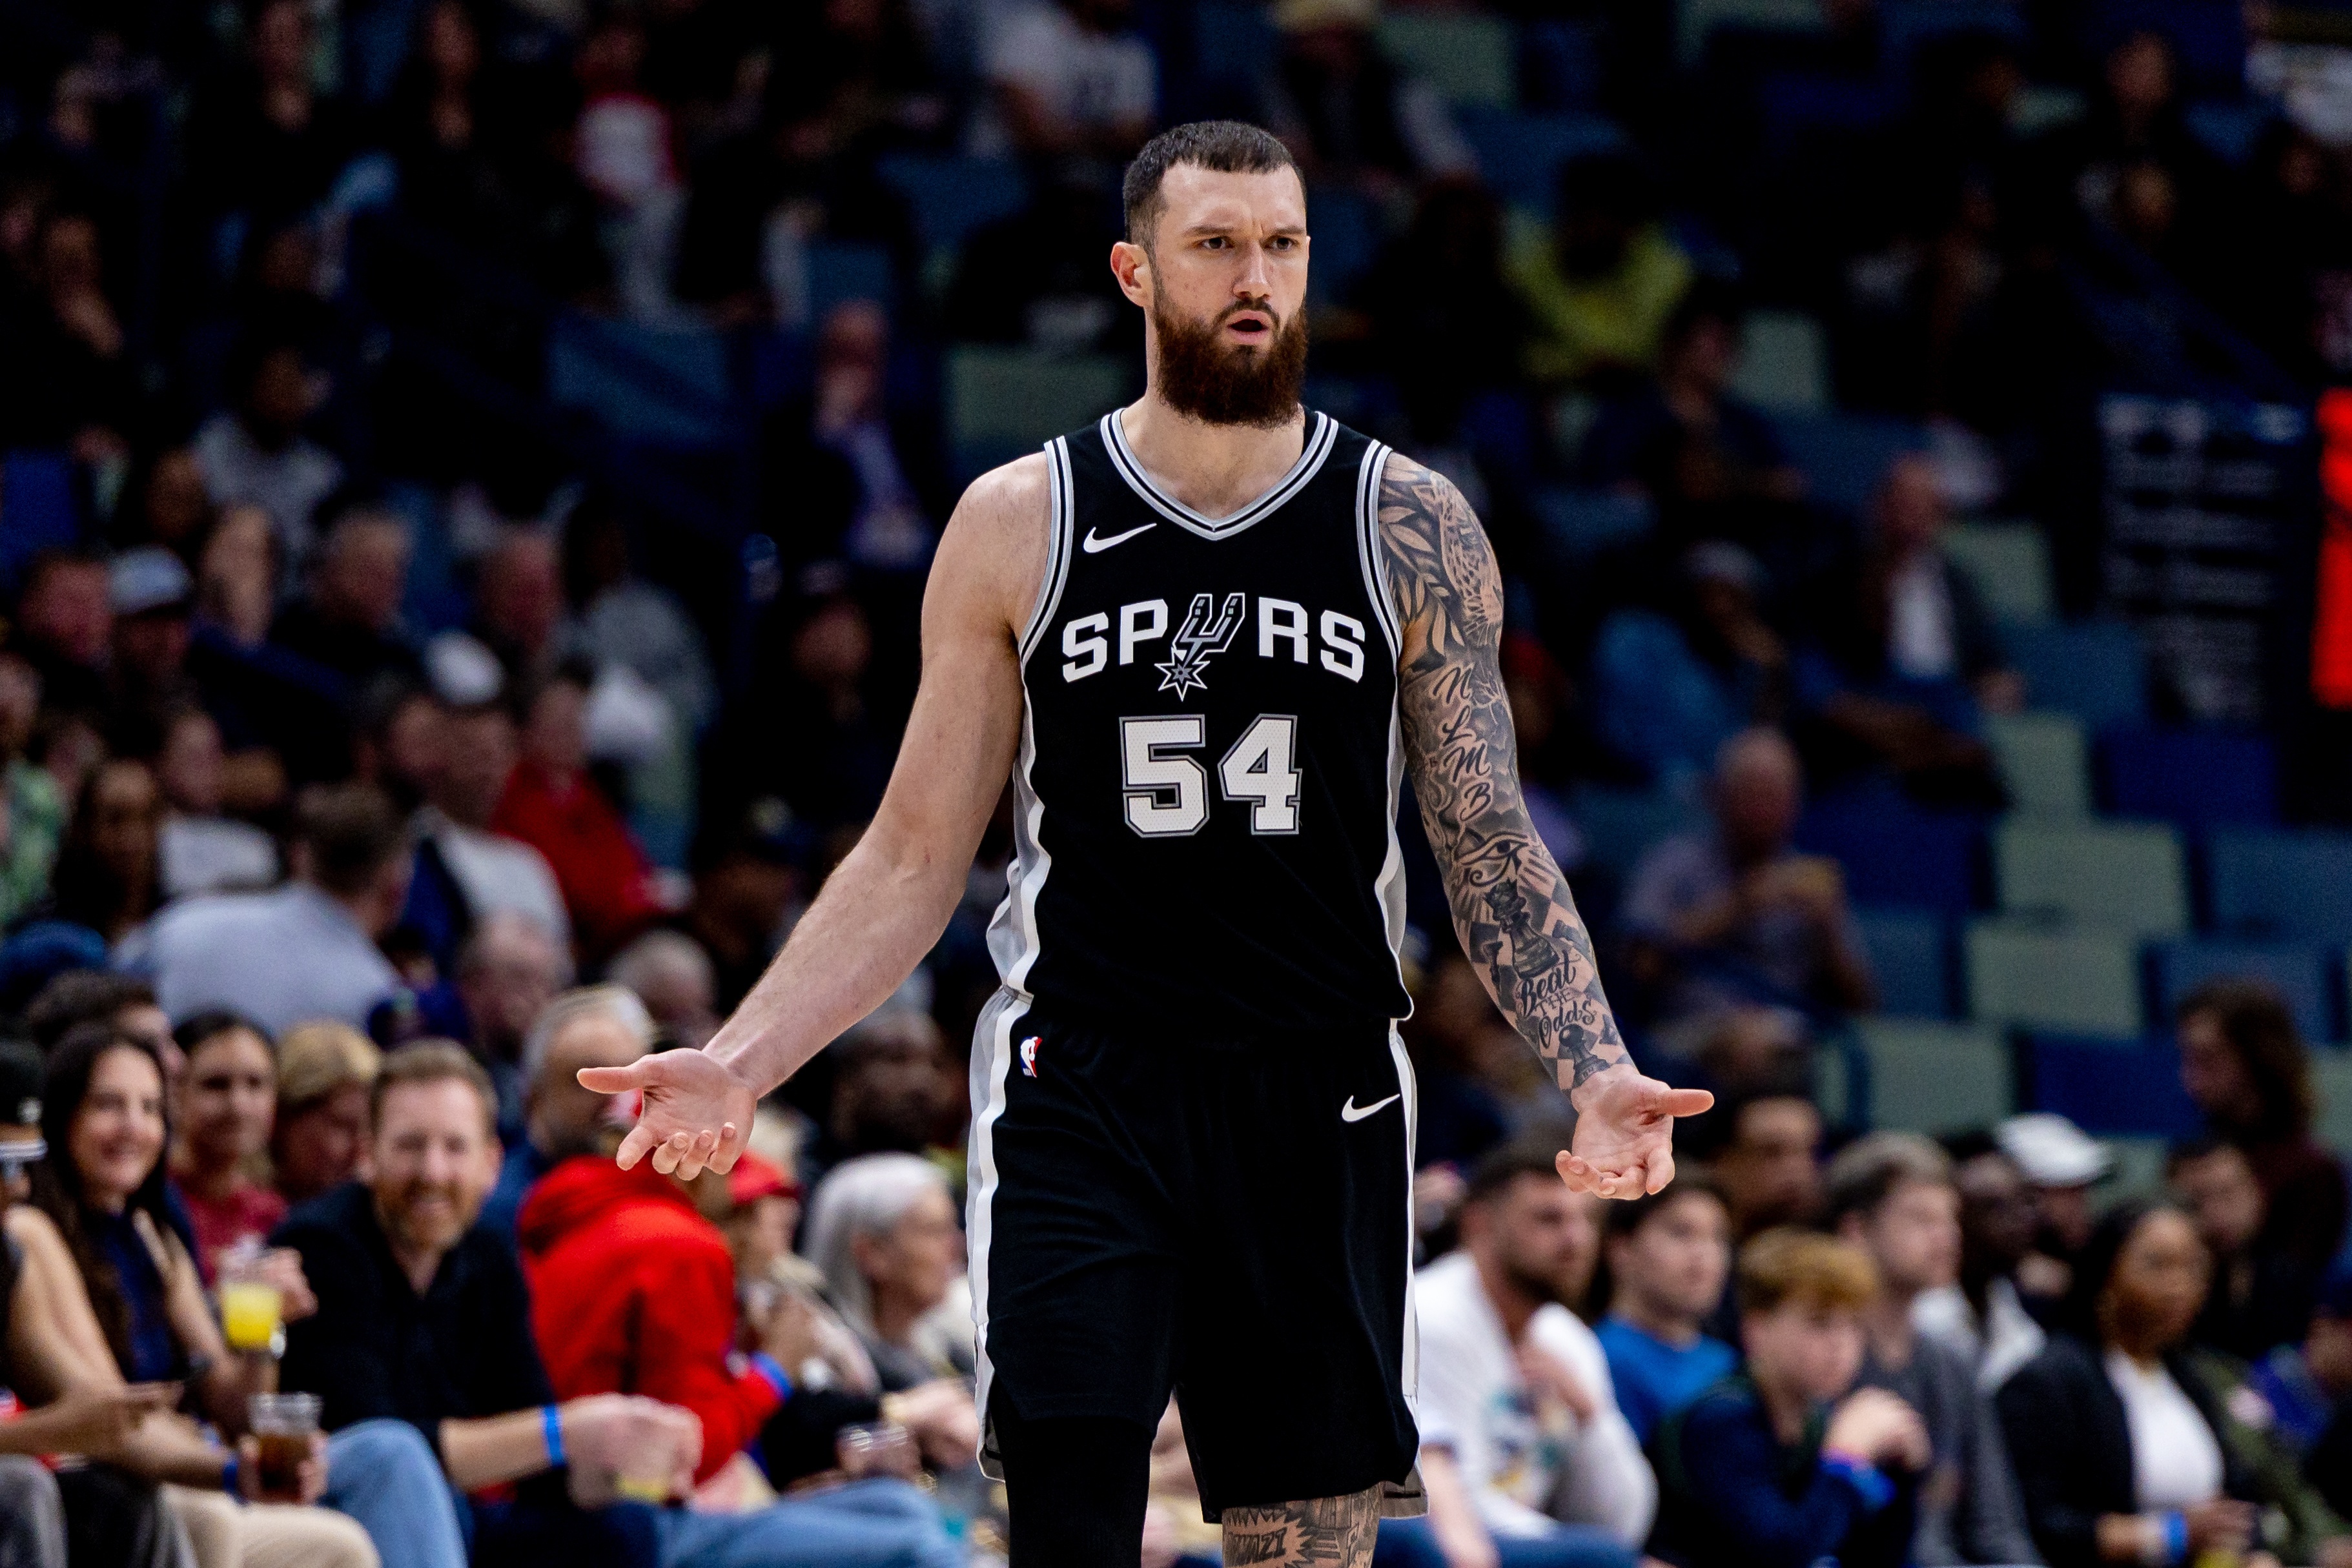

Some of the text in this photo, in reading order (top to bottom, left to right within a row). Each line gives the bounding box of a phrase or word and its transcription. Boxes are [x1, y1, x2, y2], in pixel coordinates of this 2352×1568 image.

[1062, 592, 1365, 702] SPURS
[1119, 713, 1302, 838] 54
[1515, 949, 1581, 1017] Beat
[1538, 999, 1597, 1049] Odds
